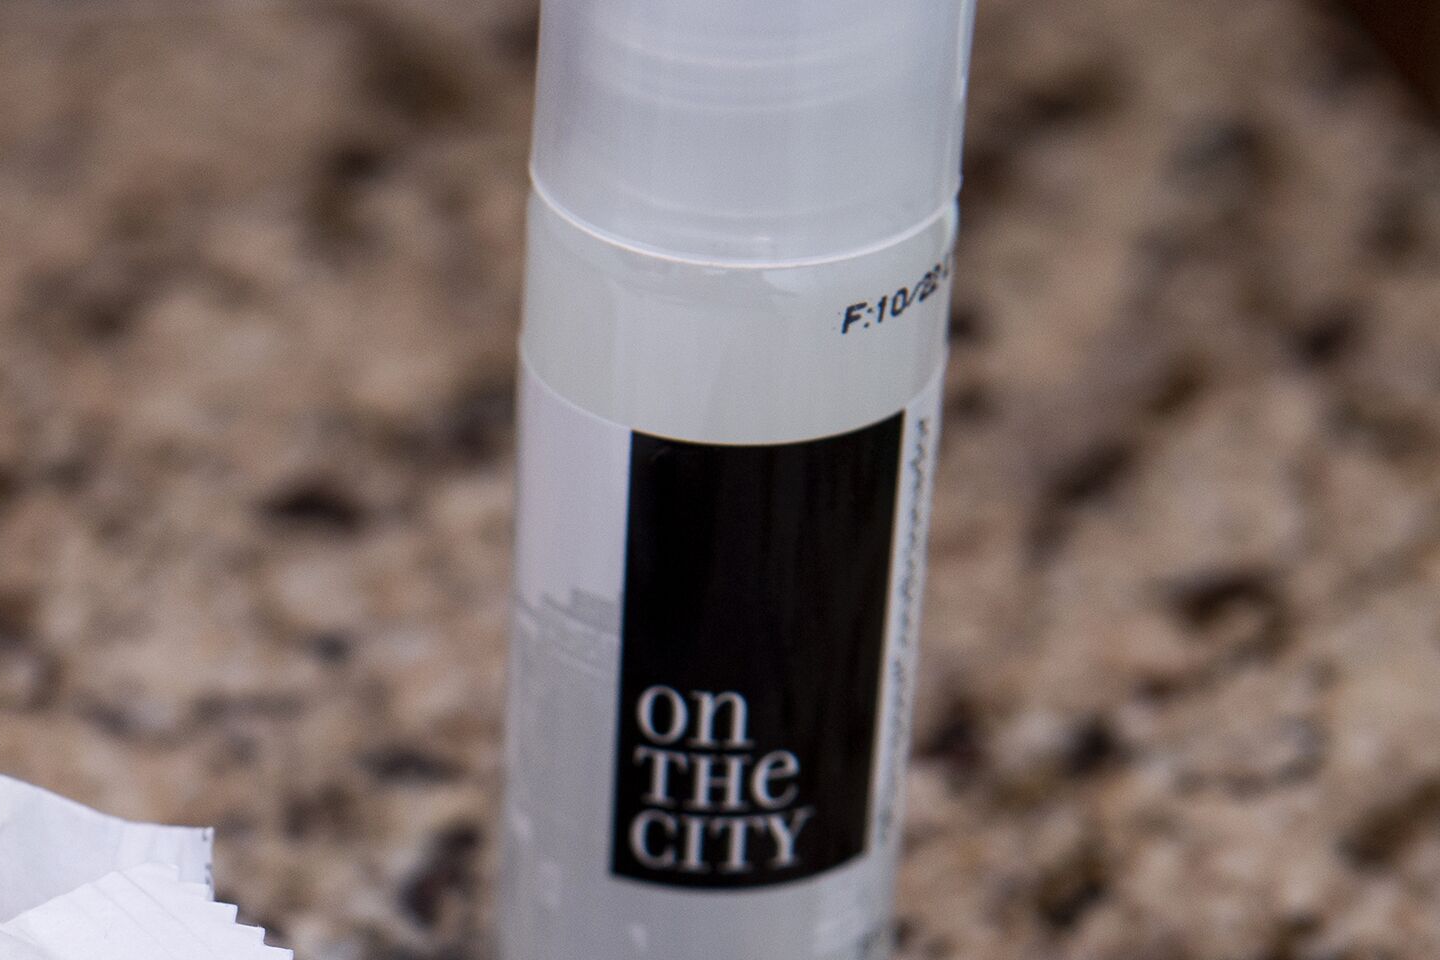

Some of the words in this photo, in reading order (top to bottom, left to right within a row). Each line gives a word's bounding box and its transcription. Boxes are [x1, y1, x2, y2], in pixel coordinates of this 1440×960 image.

[636, 684, 754, 748] on
[633, 745, 801, 811] THe
[628, 804, 814, 873] CITY
